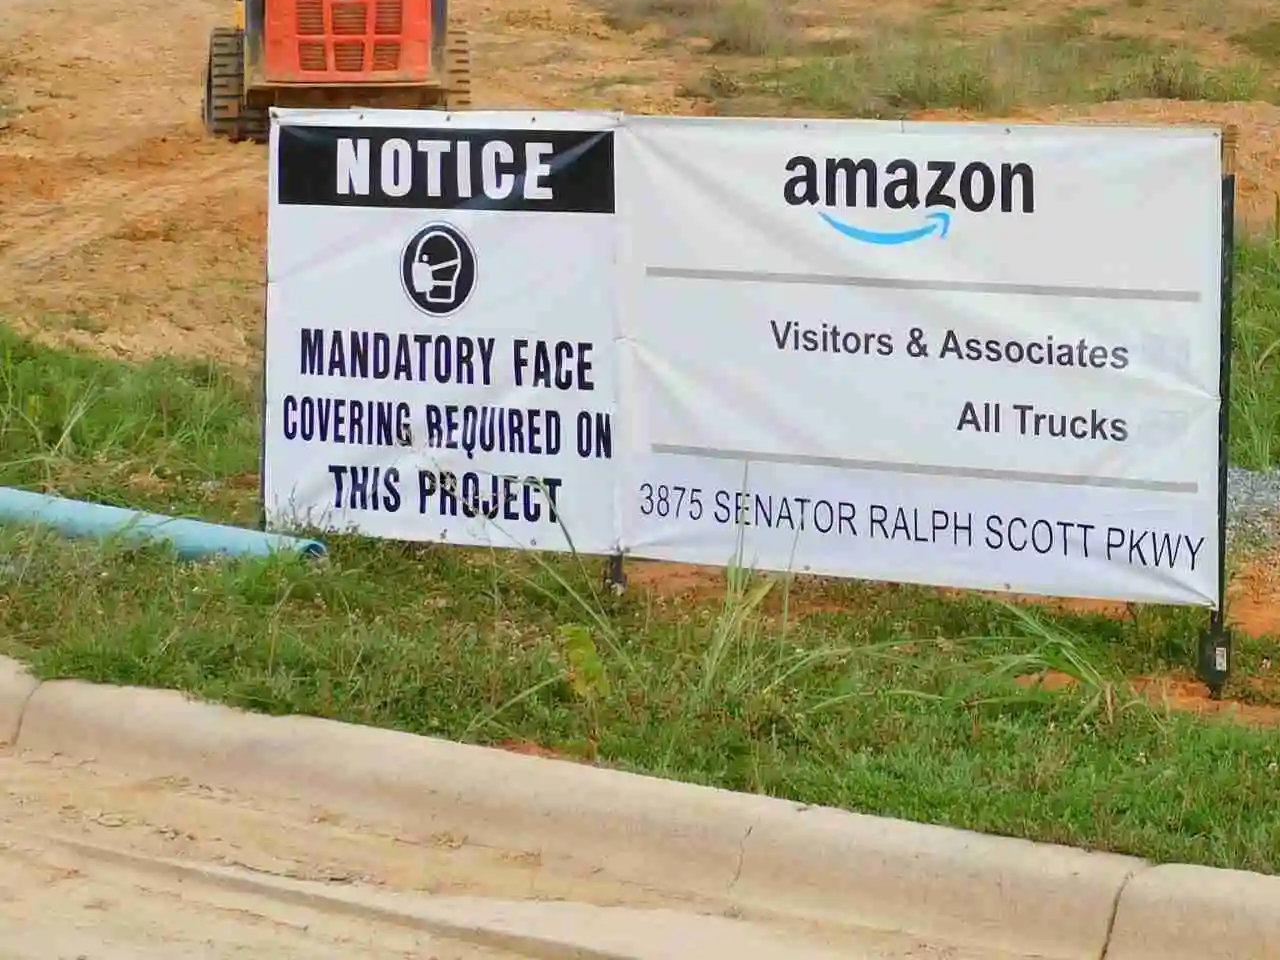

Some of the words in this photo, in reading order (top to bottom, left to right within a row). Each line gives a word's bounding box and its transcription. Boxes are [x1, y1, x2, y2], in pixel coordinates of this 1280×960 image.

[335, 138, 554, 200] NOTICE
[783, 152, 1034, 213] amazon
[300, 328, 496, 385] MANDATORY
[513, 339, 594, 391] FACE
[770, 320, 894, 357] Visitors
[905, 328, 929, 359] &
[939, 330, 1130, 370] Associates
[283, 395, 412, 447] COVERING
[426, 404, 561, 459] REQUIRED
[577, 411, 612, 459] ON
[956, 401, 1000, 433] All
[1013, 403, 1129, 442] Trucks
[328, 464, 401, 513] THIS
[418, 469, 562, 523] PROJECT
[639, 483, 703, 521] 3875
[713, 490, 858, 537] SENATOR
[869, 503, 973, 547] RALPH
[984, 515, 1095, 558] SCOTT
[1106, 526, 1205, 572] PKWY
